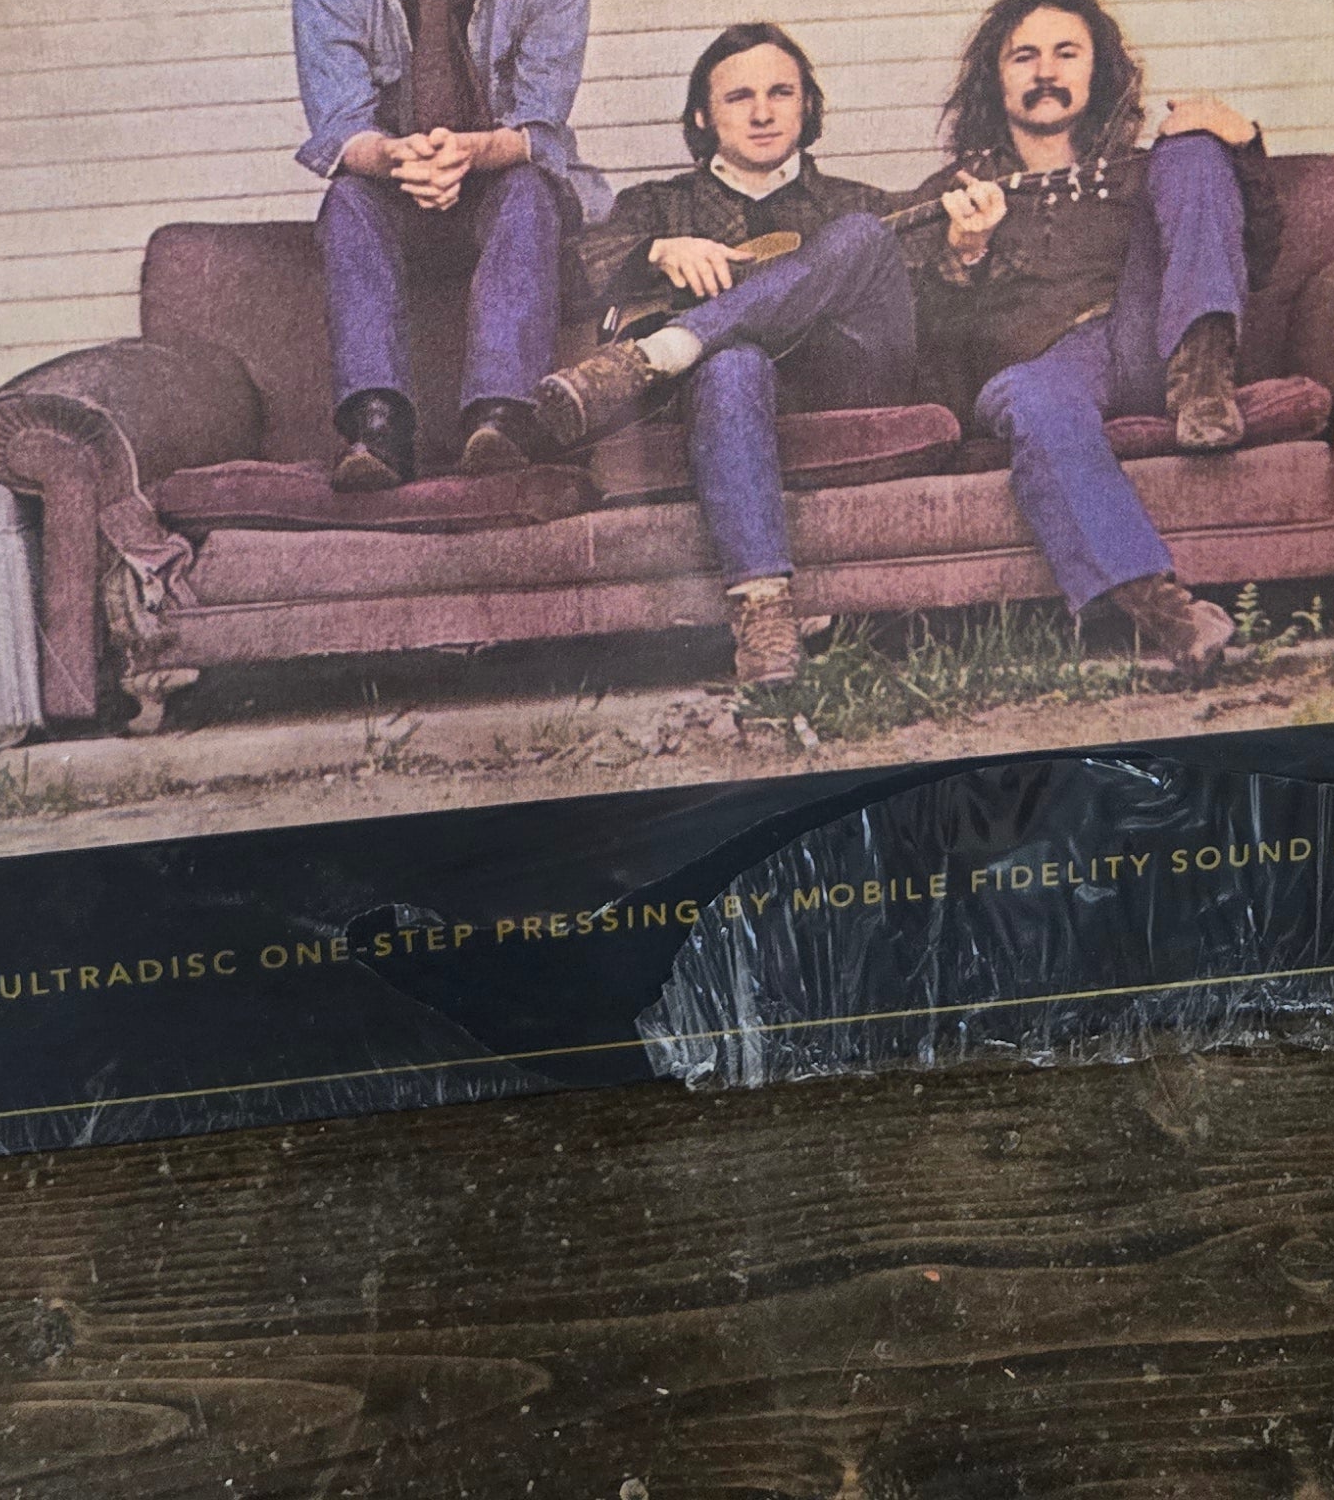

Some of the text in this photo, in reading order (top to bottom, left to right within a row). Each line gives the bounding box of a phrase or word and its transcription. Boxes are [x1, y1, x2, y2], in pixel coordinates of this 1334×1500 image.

[259, 923, 475, 970] ONE-STEP
[496, 899, 701, 945] PRESSING
[723, 894, 768, 920] BY
[794, 872, 948, 912] MOBILE
[970, 852, 1152, 894] FIDELITY
[1171, 836, 1313, 874] SOUND
